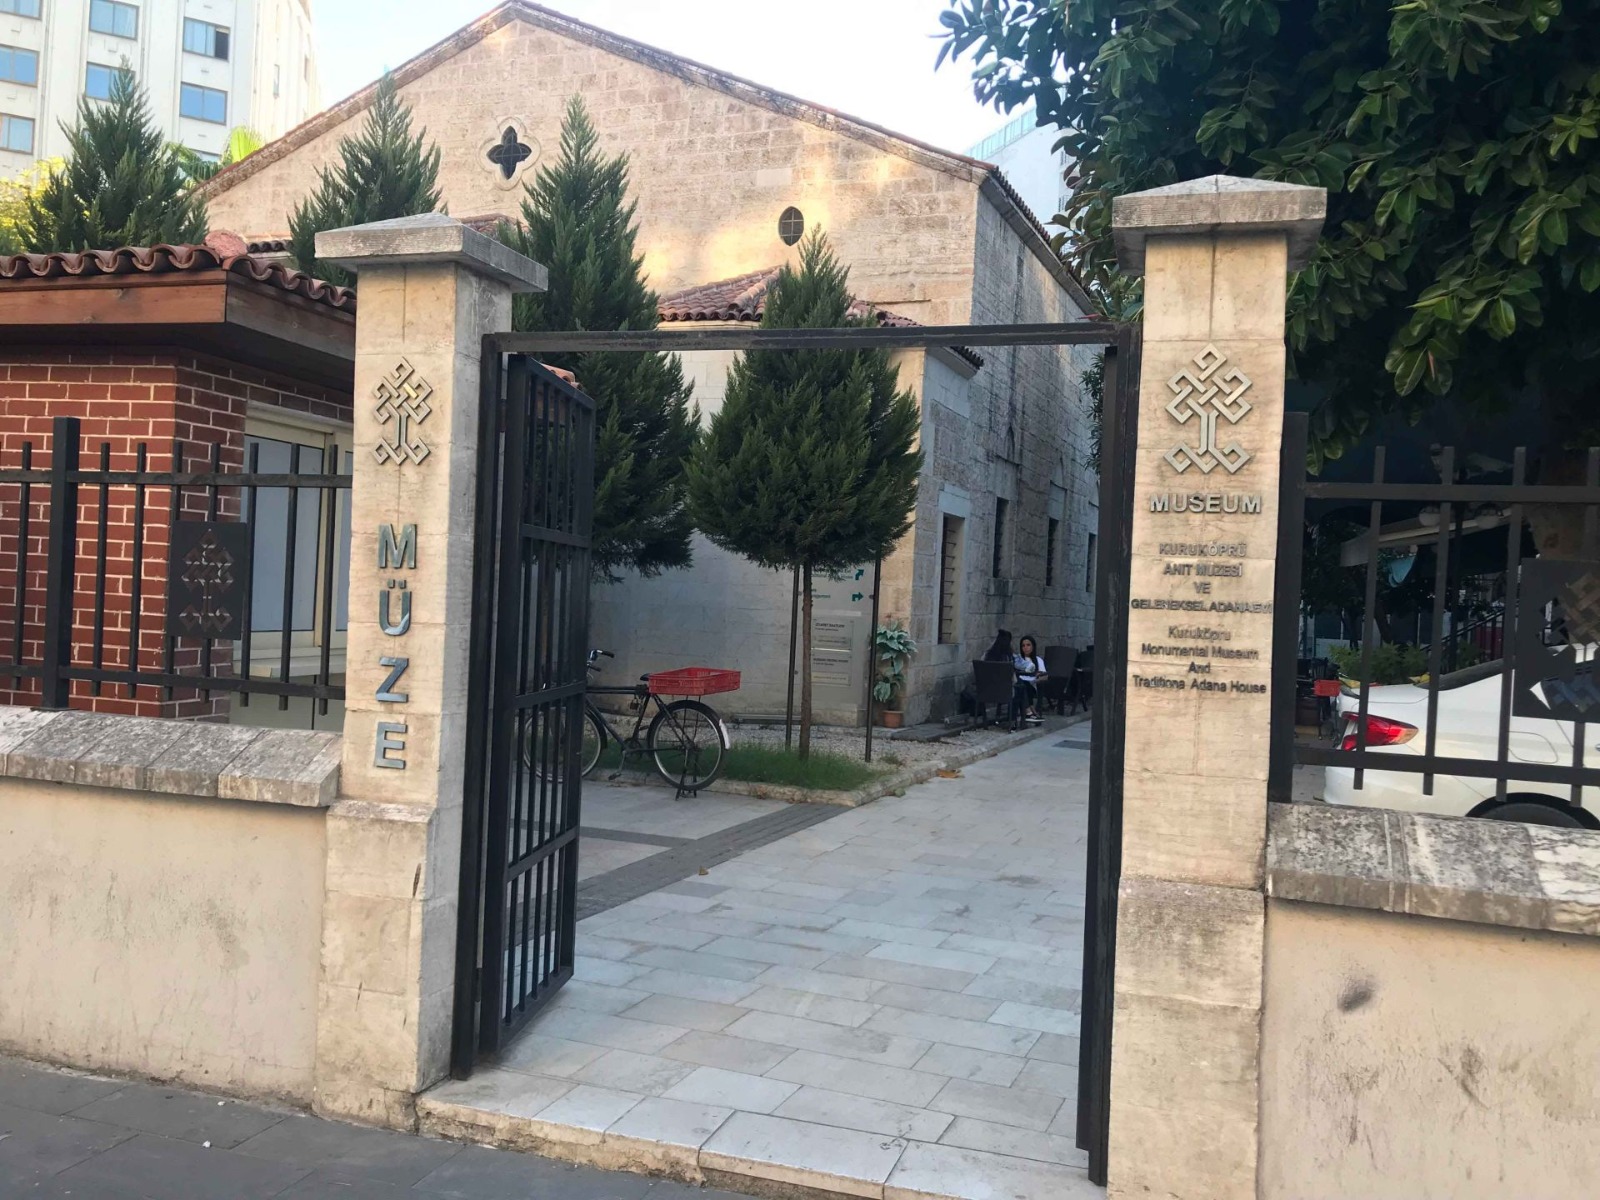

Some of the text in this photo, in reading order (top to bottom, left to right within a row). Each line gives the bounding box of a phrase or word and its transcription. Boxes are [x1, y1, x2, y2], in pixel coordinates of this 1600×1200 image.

[1150, 493, 1262, 514] MUSEUM
[1159, 541, 1247, 557] KURUKÖPRÜ
[1163, 563, 1193, 576] ANIT
[1193, 581, 1211, 594] VE
[1131, 598, 1207, 612] GELENEKSEL
[374, 523, 418, 770] MÜZE
[1141, 643, 1259, 660] Monumental Museum
[1188, 661, 1211, 674] And
[1190, 678, 1226, 692] Adana
[1230, 680, 1267, 693] House
